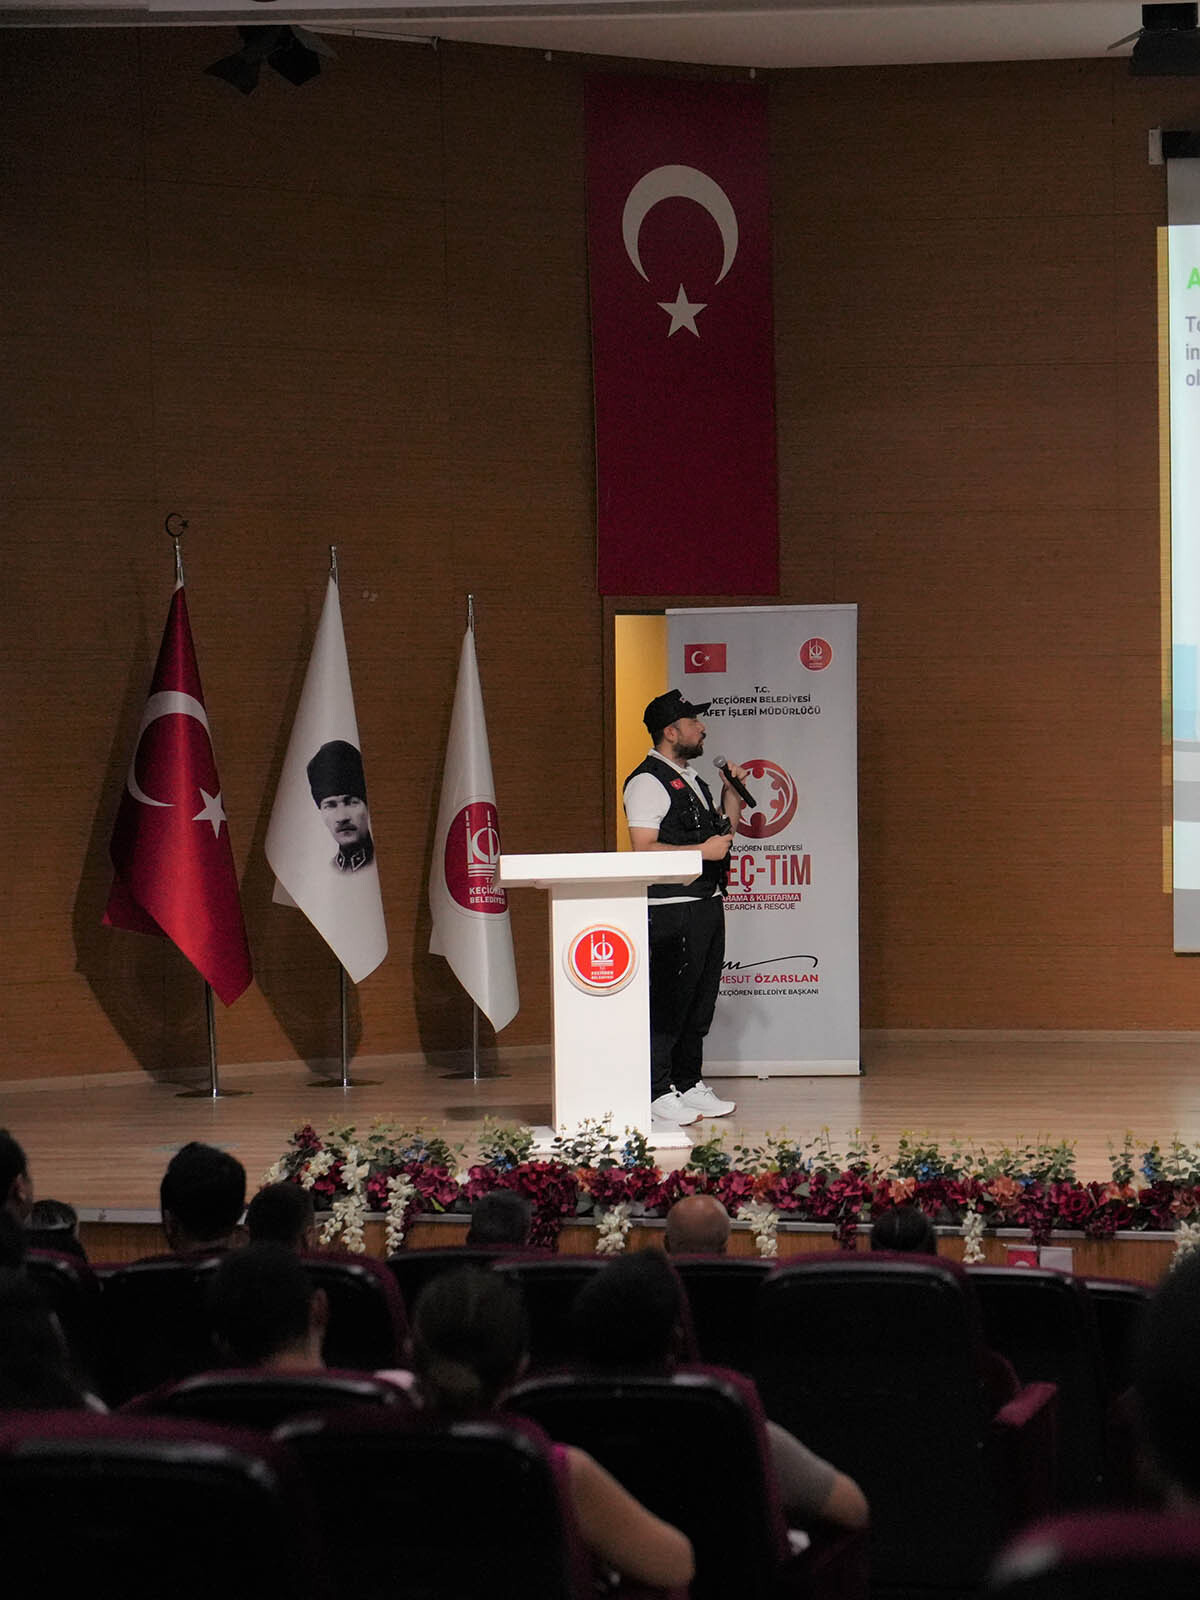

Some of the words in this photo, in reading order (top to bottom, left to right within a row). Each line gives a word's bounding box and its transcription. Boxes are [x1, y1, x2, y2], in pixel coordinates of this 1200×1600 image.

[754, 686, 770, 694] T.C.
[712, 694, 757, 706] KEÇİÖREN
[759, 693, 811, 704] BELEDİYESİ
[702, 709, 726, 717] AFET
[728, 706, 757, 718] İŞLERİ
[760, 705, 821, 716] MÜDÜRLÜĞÜ
[757, 893, 800, 902] KURTARMA
[724, 903, 756, 911] SEARCH
[763, 902, 796, 910] RESCUE
[754, 973, 819, 984] ÖZARSLAN
[753, 988, 787, 996] BELEDİYE
